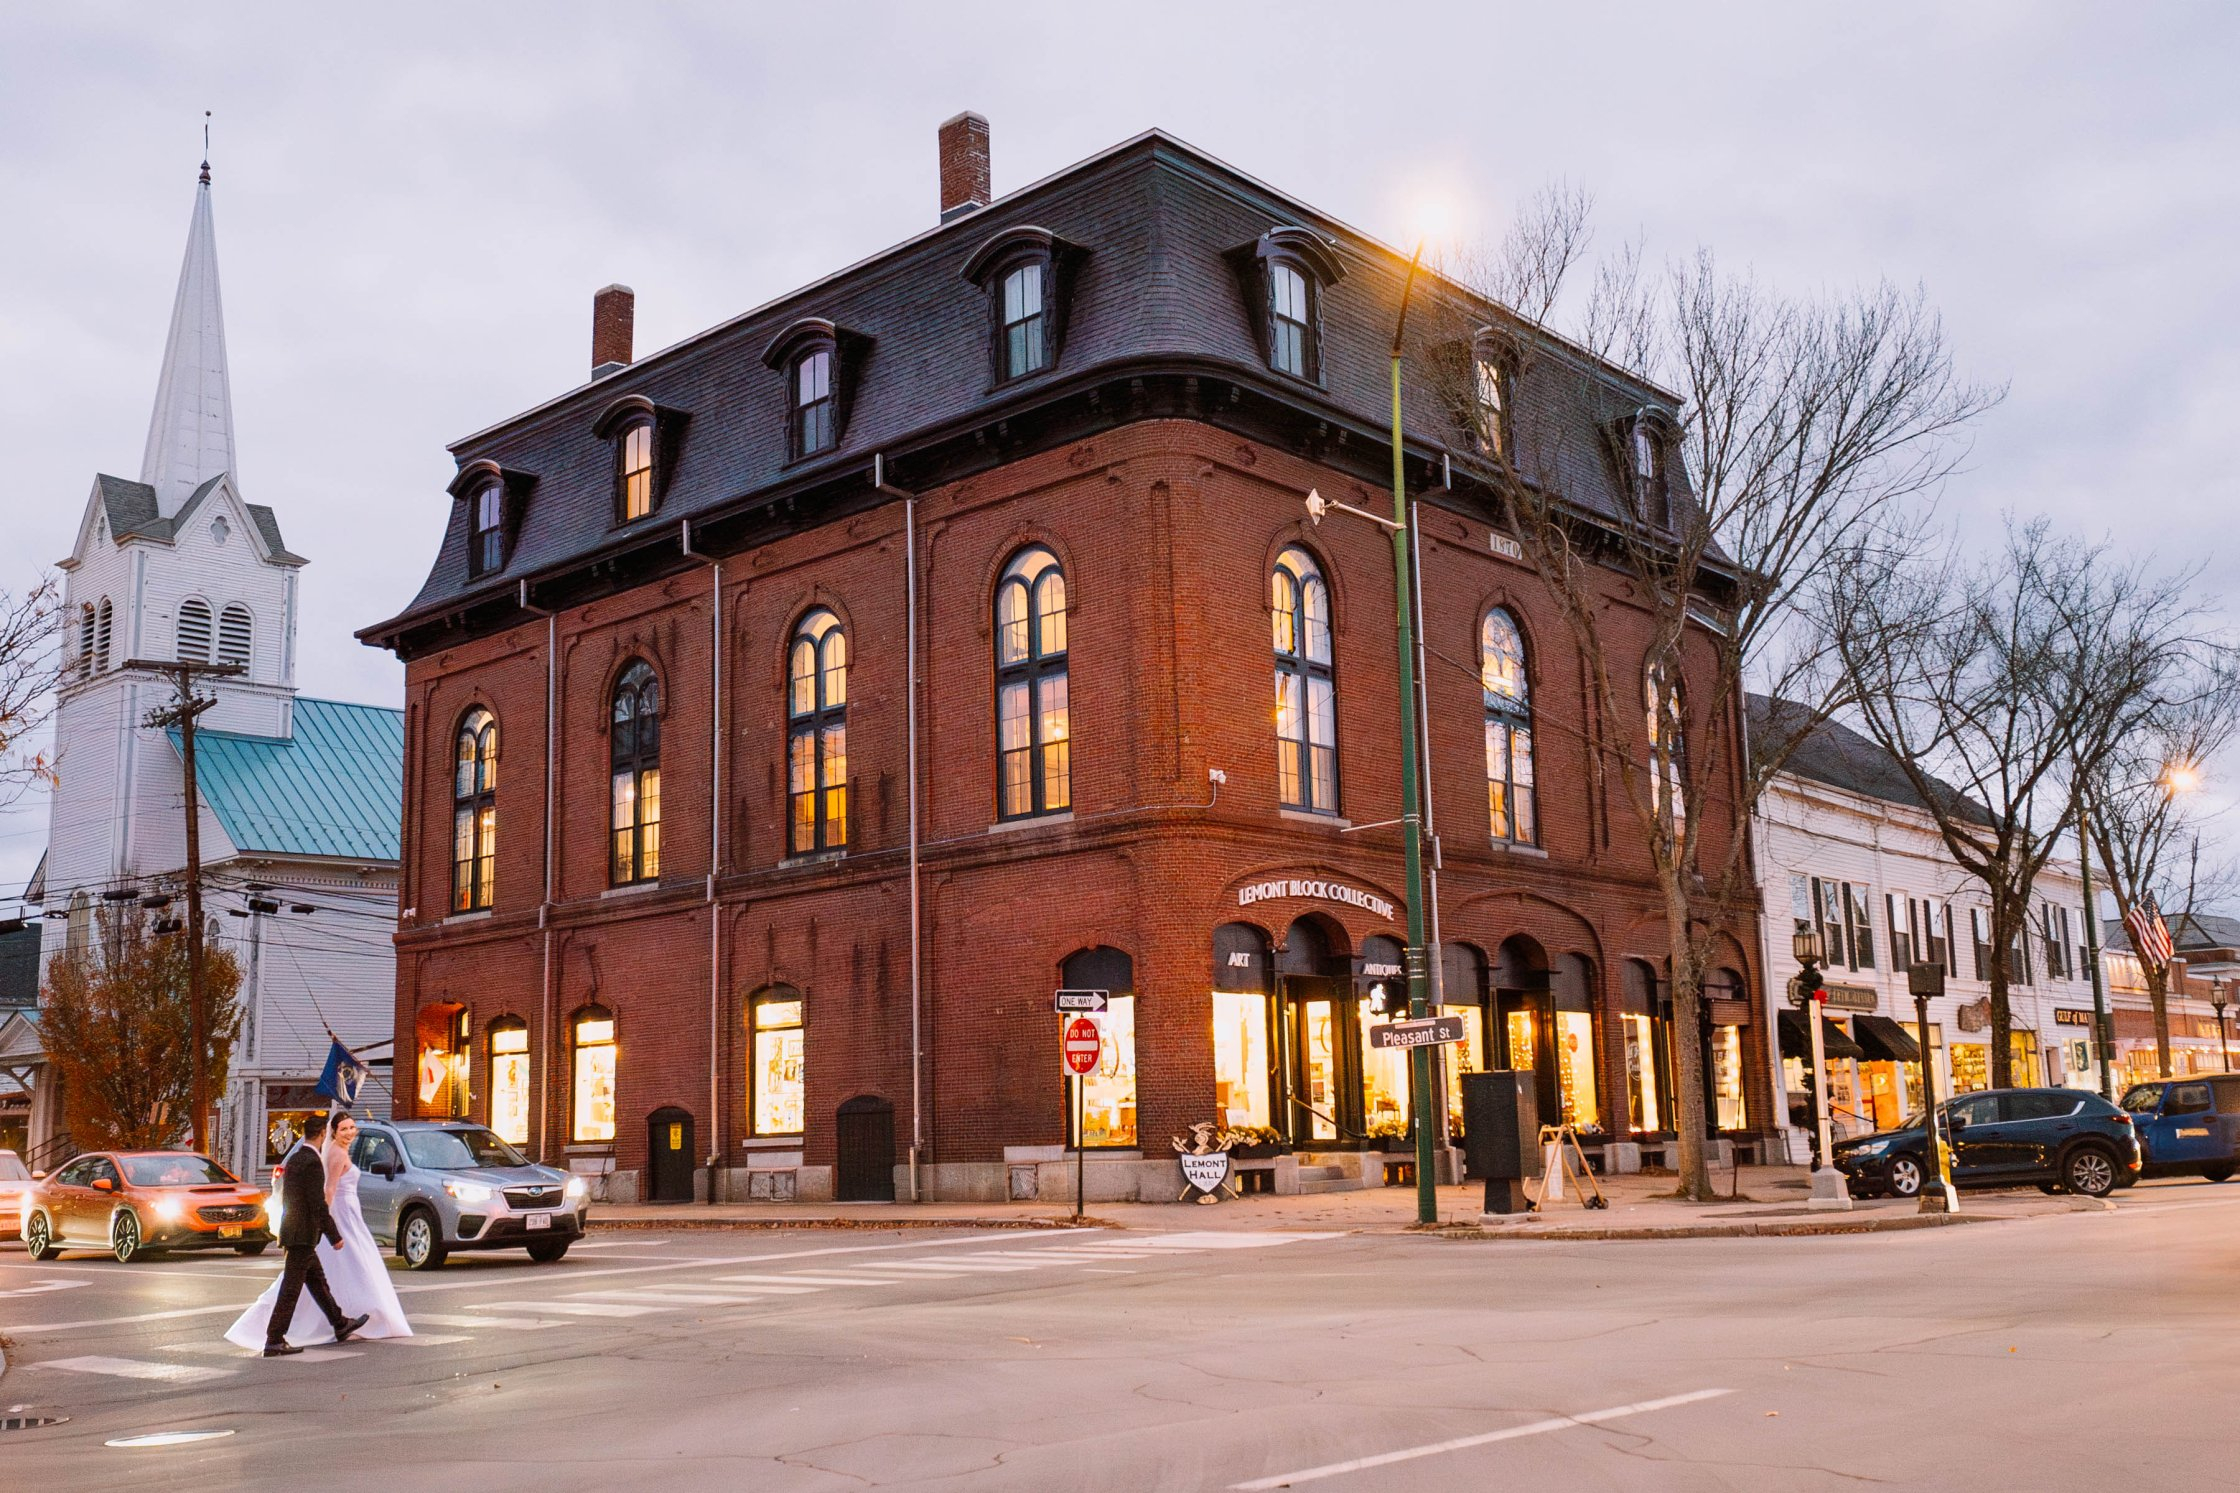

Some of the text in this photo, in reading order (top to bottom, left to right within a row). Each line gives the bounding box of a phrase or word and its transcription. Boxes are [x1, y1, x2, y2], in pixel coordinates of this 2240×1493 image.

[1238, 880, 1394, 921] LEMONT BLOCK COLLECTIVE
[1227, 951, 1251, 968] ART
[1363, 963, 1403, 976] ANTIQUES
[1061, 997, 1093, 1006] ONE WAY
[2056, 1010, 2072, 1022] GULF
[1069, 1028, 1095, 1039] DO NOT
[1382, 1027, 1451, 1047] Pleasant St
[1071, 1053, 1093, 1063] ENTER
[1183, 1159, 1227, 1168] LEMONT
[1189, 1170, 1221, 1180] HALL
